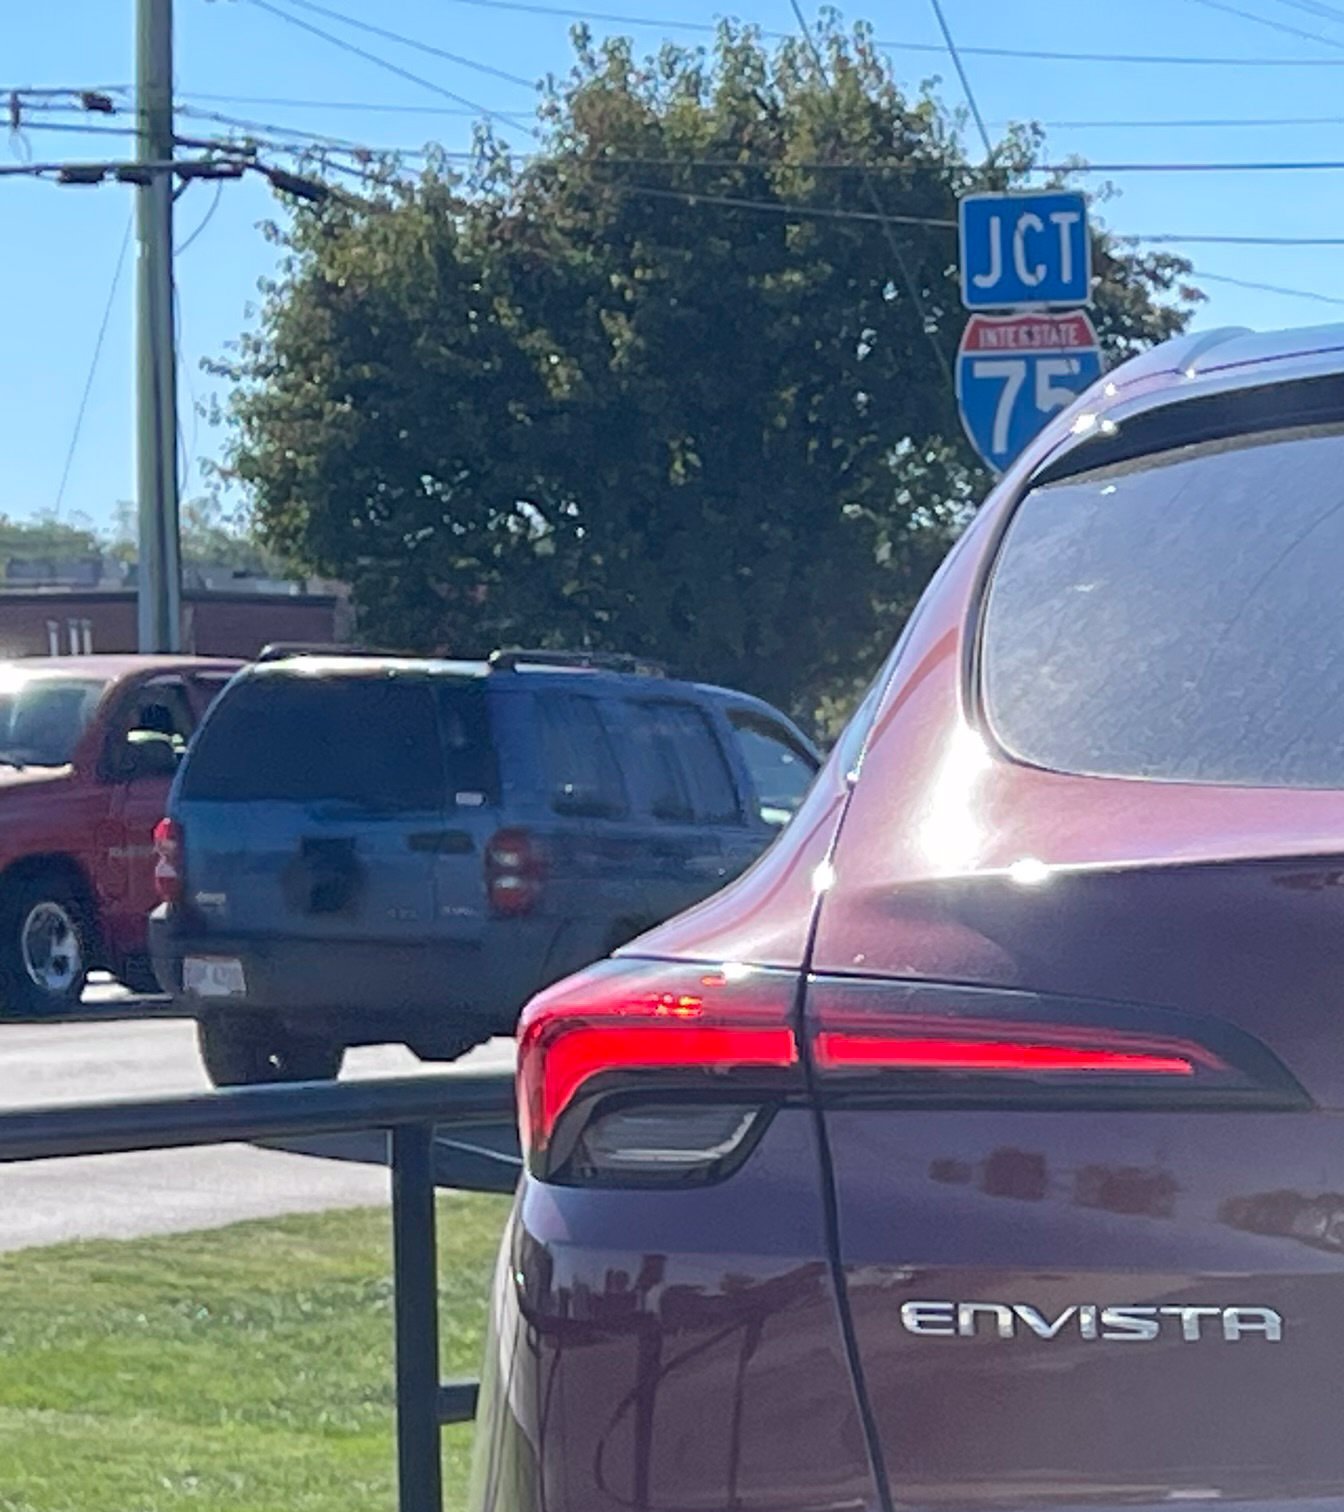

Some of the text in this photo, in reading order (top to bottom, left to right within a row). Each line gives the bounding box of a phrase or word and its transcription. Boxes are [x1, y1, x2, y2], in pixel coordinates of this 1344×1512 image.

[973, 213, 1080, 288] JCT
[978, 325, 1080, 347] INTERSTATE
[901, 1302, 1282, 1341] ENVISTA
